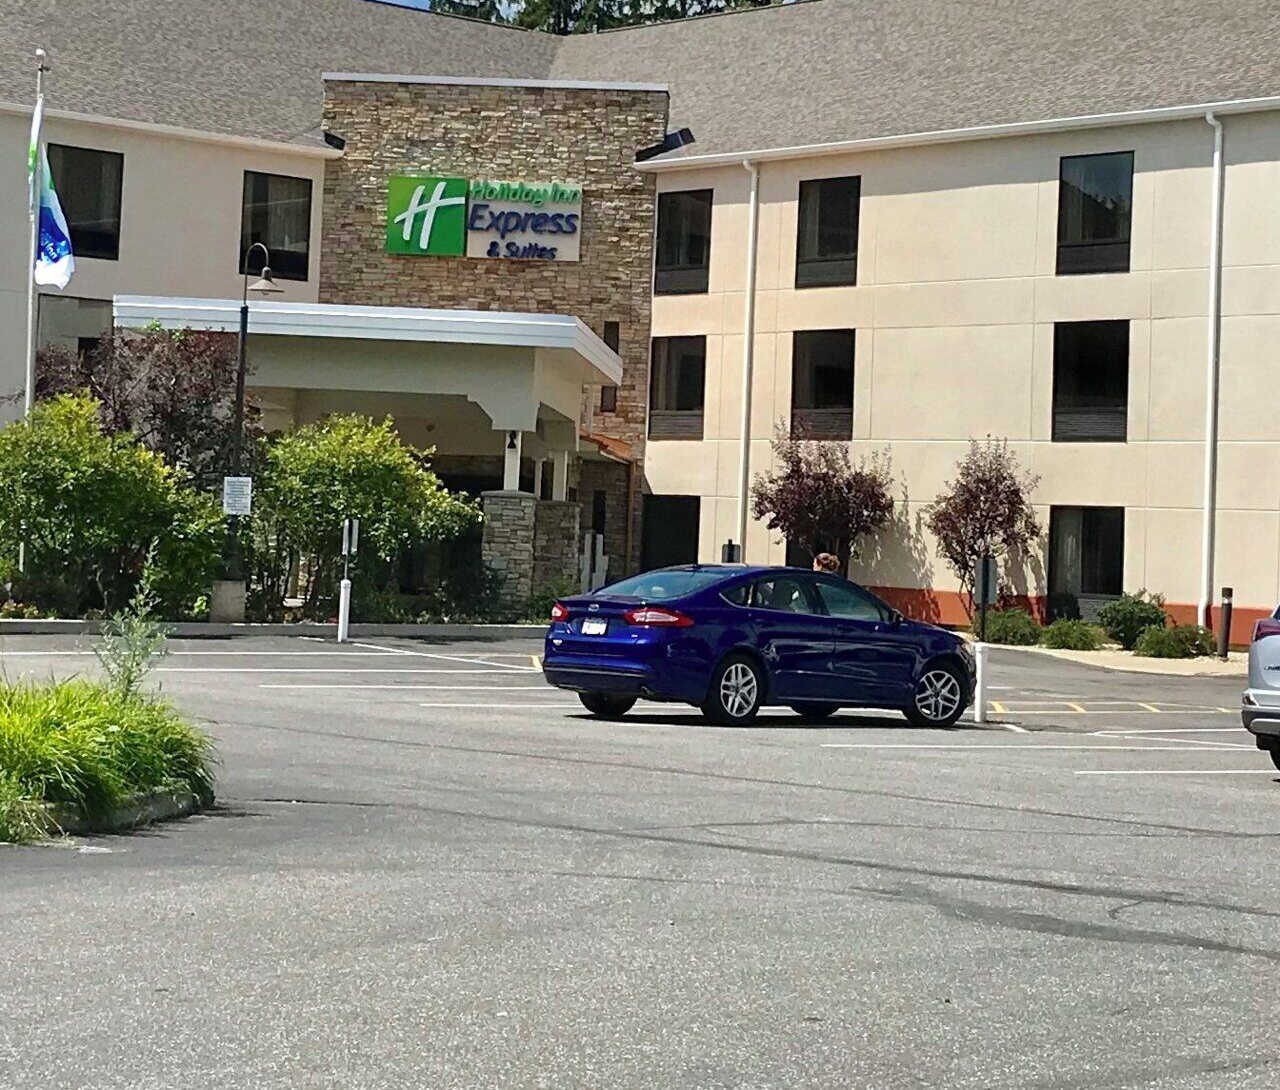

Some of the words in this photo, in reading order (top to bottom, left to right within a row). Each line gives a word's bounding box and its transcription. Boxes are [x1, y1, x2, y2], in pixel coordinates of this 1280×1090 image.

[471, 180, 548, 208] Holiday
[550, 183, 581, 204] Inn
[468, 203, 579, 239] Express
[487, 241, 499, 258] &
[504, 241, 558, 259] Suites
